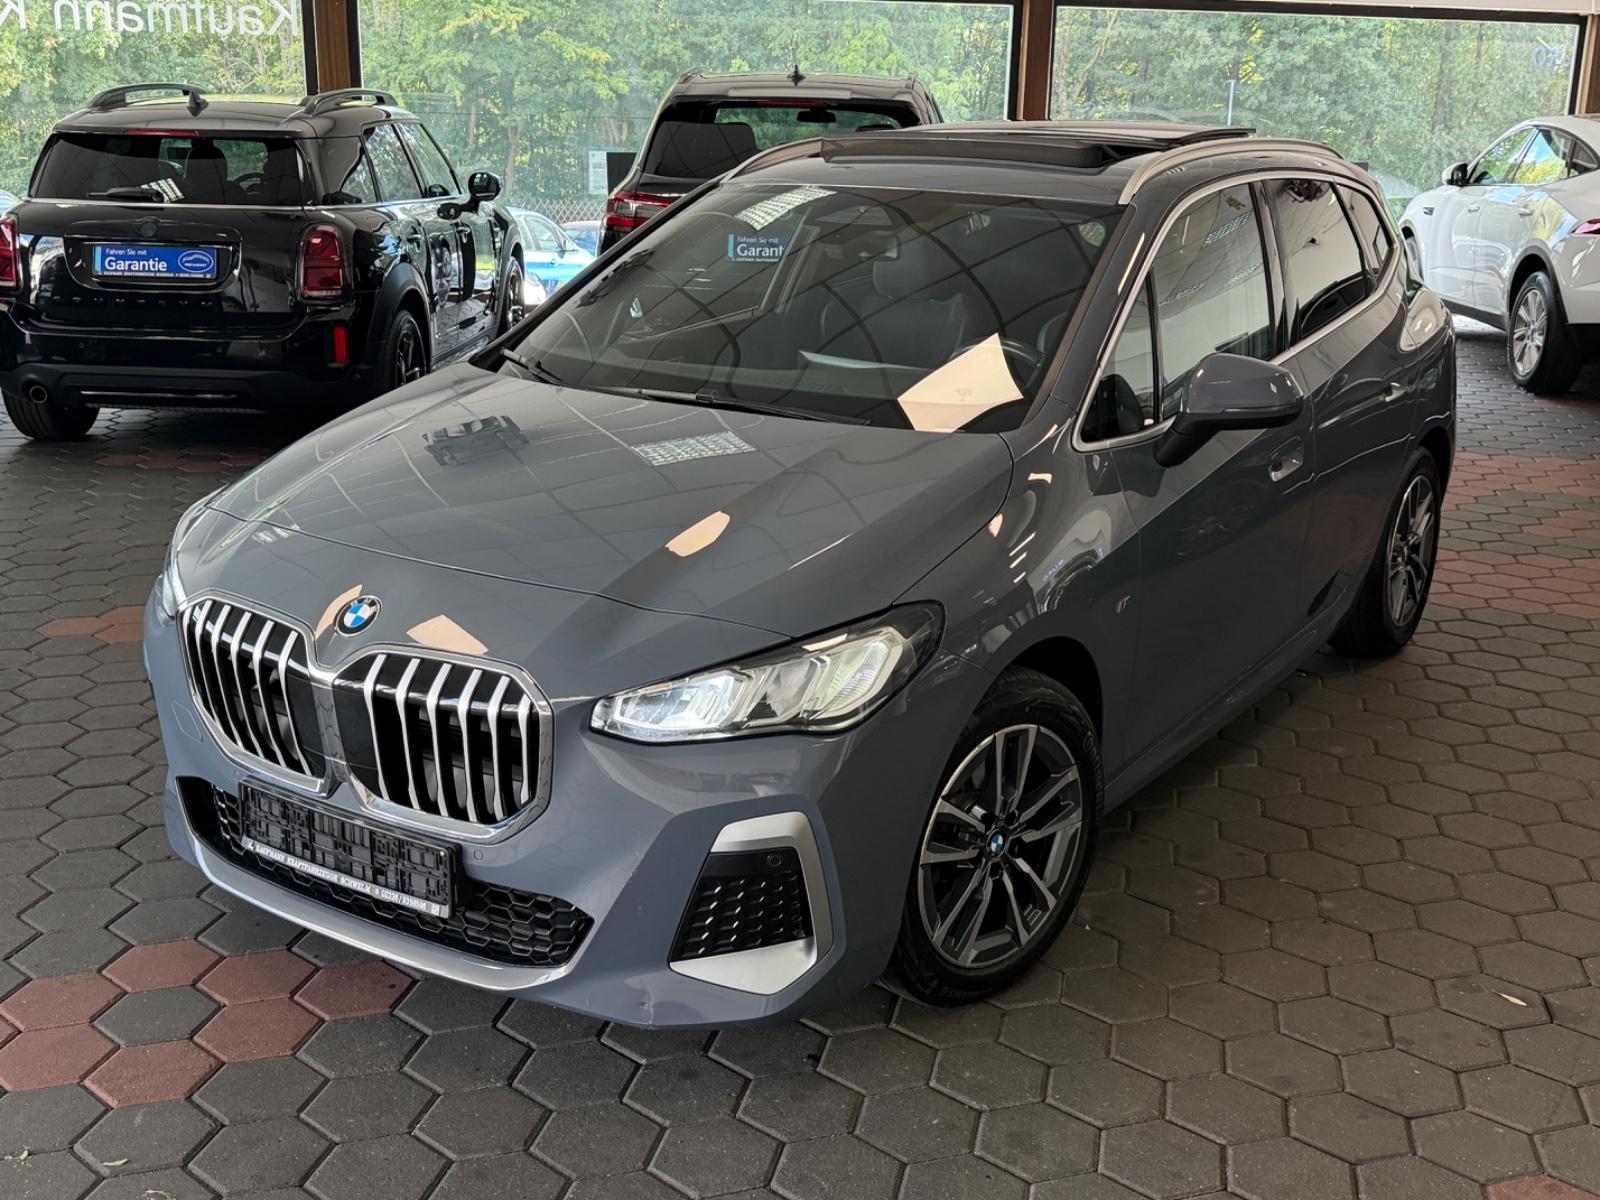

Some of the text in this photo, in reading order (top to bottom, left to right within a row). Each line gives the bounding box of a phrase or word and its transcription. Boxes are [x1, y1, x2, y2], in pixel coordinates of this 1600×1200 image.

[105, 248, 126, 256] Fahren
[137, 249, 148, 257] mit
[104, 256, 168, 272] Garantie
